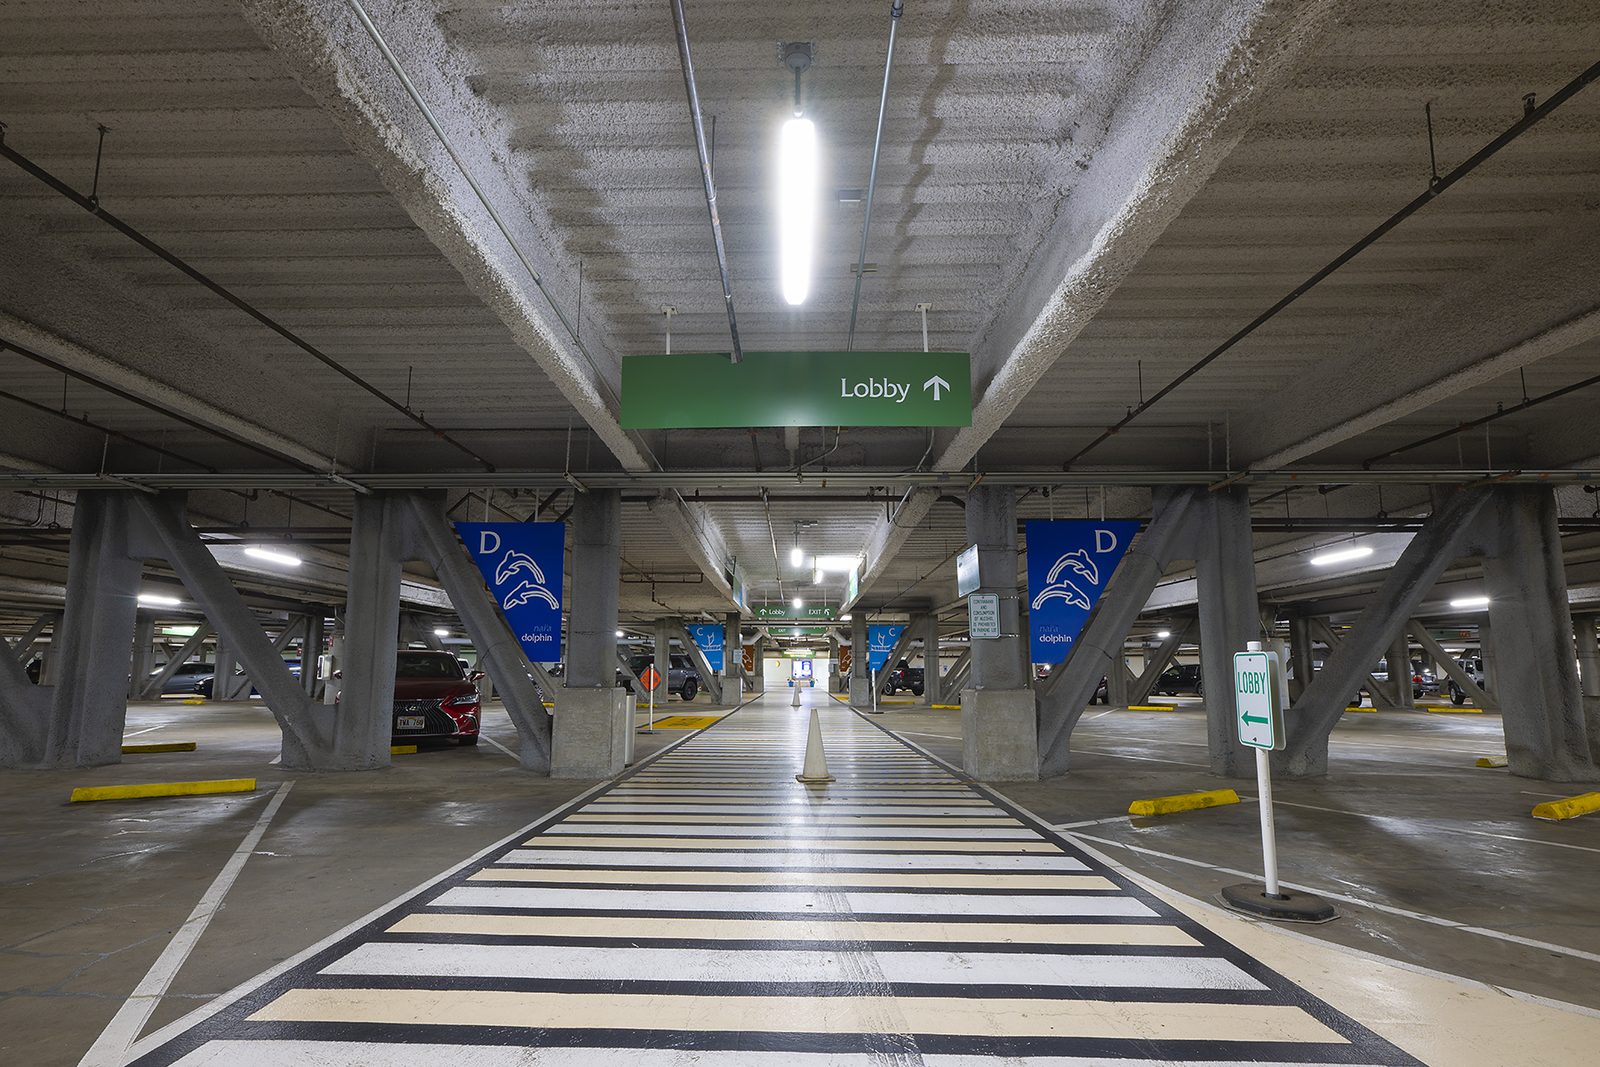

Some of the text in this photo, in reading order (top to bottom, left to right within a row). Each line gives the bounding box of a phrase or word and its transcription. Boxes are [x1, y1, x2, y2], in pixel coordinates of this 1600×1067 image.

[841, 378, 911, 403] Lobby
[480, 531, 501, 554] D
[1095, 530, 1117, 553] D
[521, 633, 553, 643] dolphin
[697, 628, 704, 636] C
[888, 628, 896, 637] C
[1039, 634, 1072, 644] dolphin
[1237, 671, 1266, 695] LOBBY
